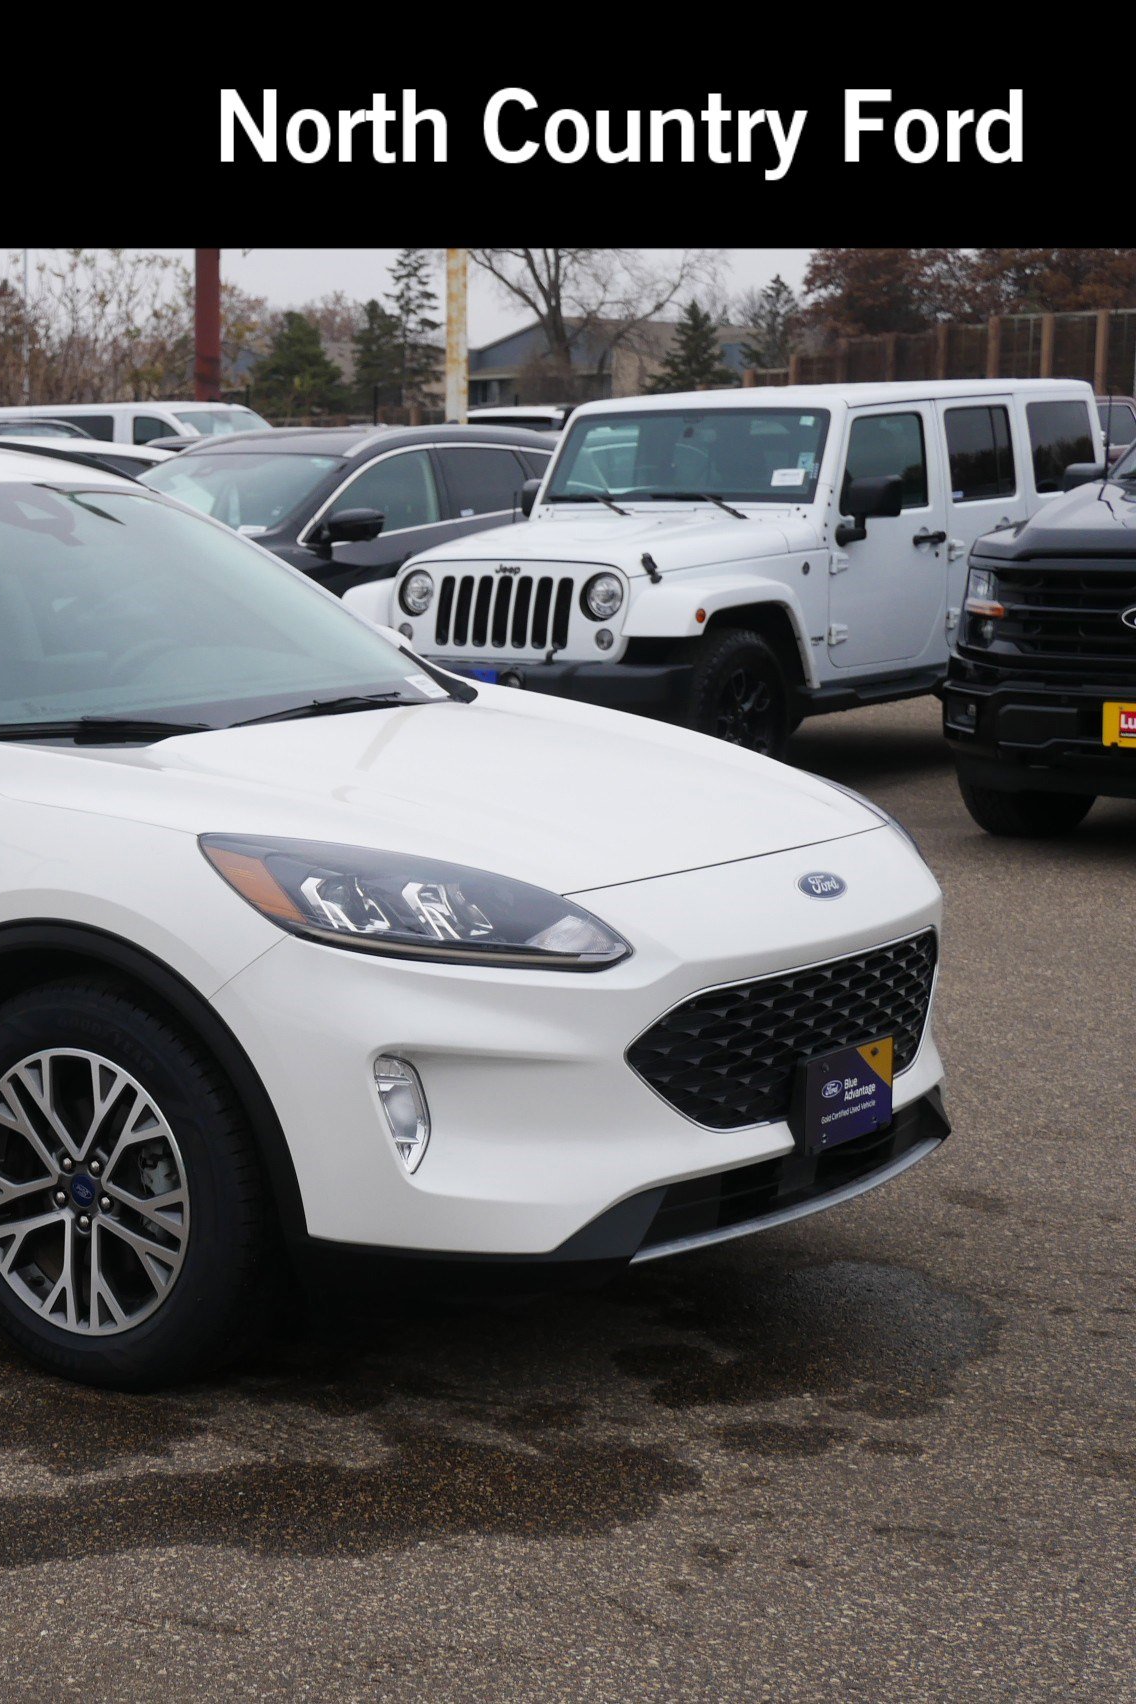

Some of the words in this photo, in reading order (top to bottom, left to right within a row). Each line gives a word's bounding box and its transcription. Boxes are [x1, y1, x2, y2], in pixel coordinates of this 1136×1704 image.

[495, 563, 521, 576] Jeep
[808, 874, 840, 894] Ford
[844, 1077, 858, 1090] Blue
[844, 1083, 876, 1101] Advantage
